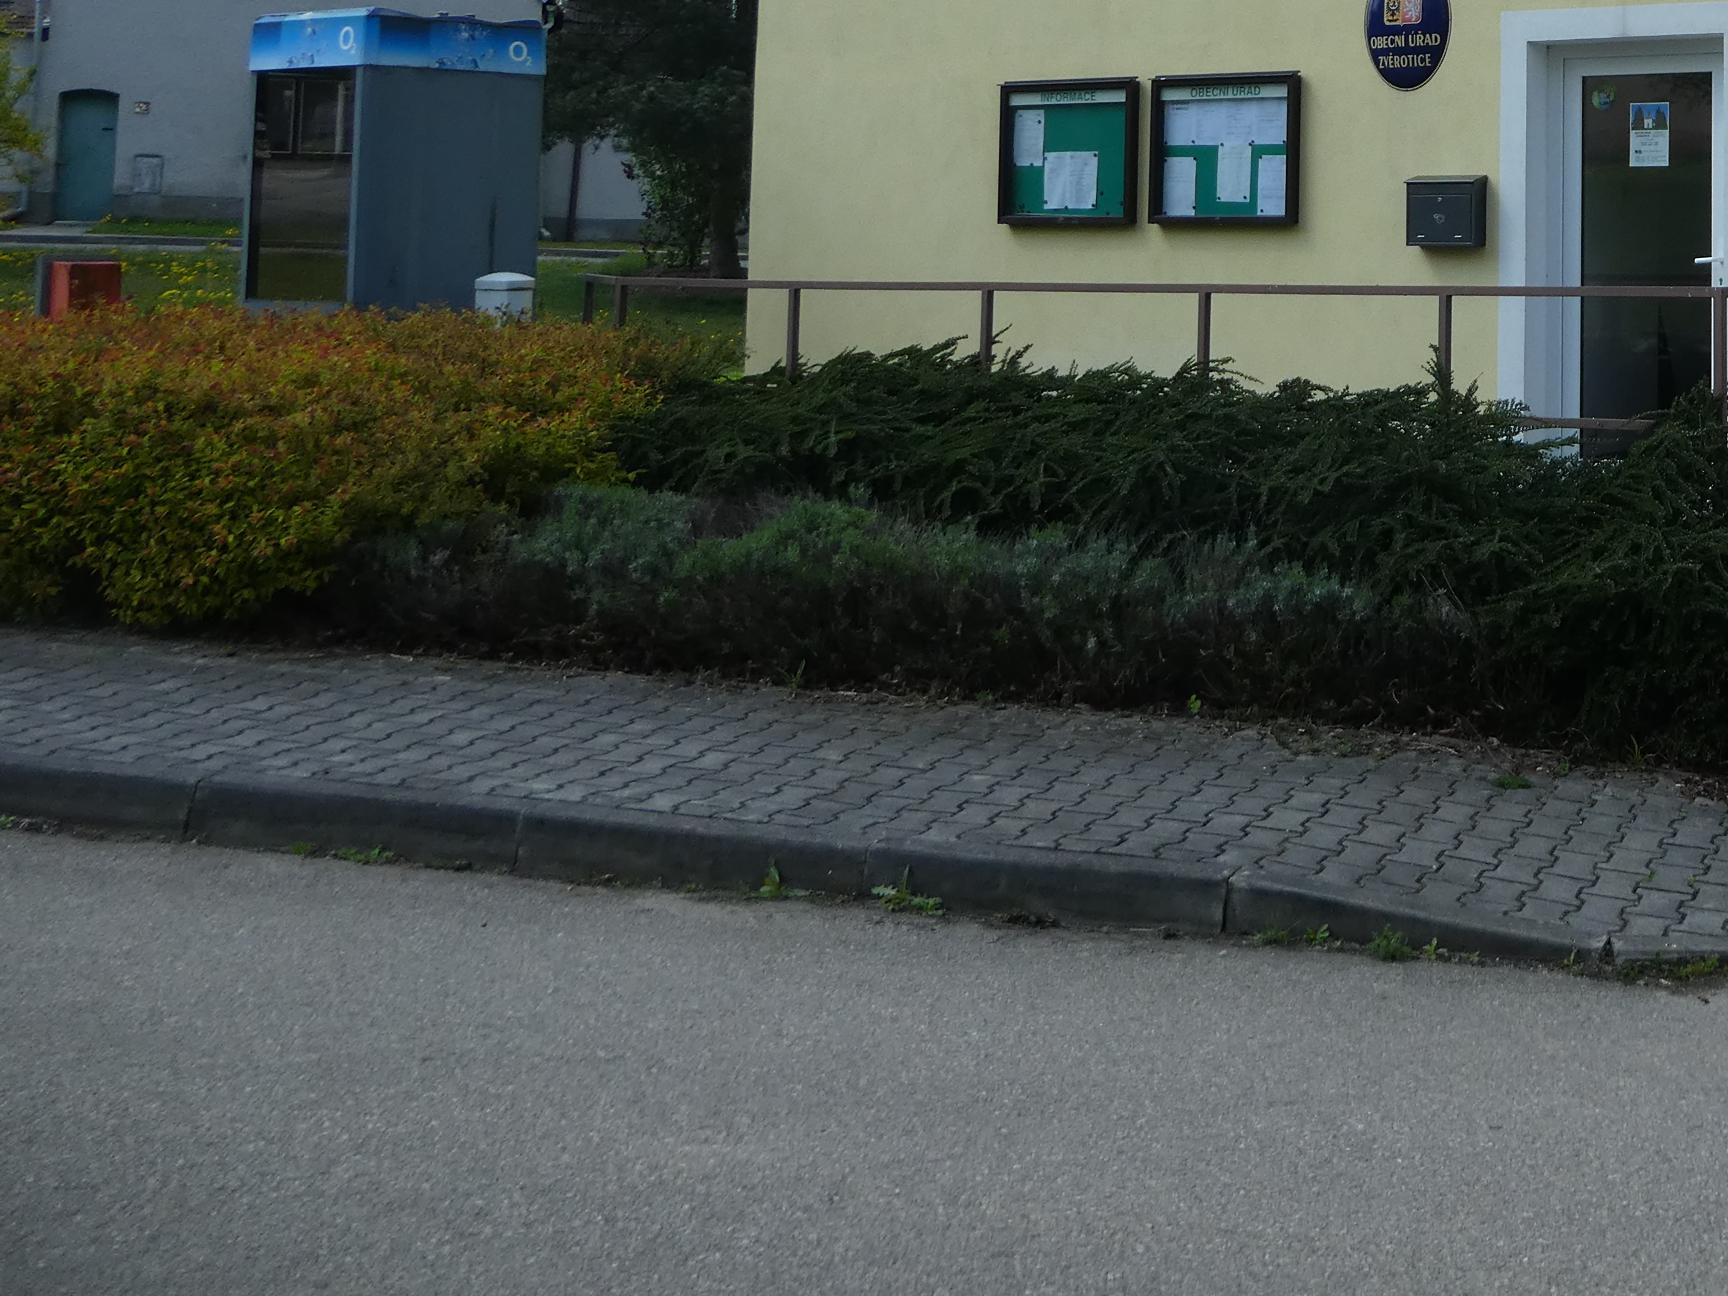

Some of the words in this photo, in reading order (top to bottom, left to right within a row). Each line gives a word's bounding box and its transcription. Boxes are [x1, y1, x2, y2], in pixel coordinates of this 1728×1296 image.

[1370, 31, 1405, 49] OBECNÍ
[1408, 30, 1441, 47] ÚŘAD
[1378, 53, 1432, 69] ZVĚROTICE
[1040, 89, 1096, 103] INFORMACE
